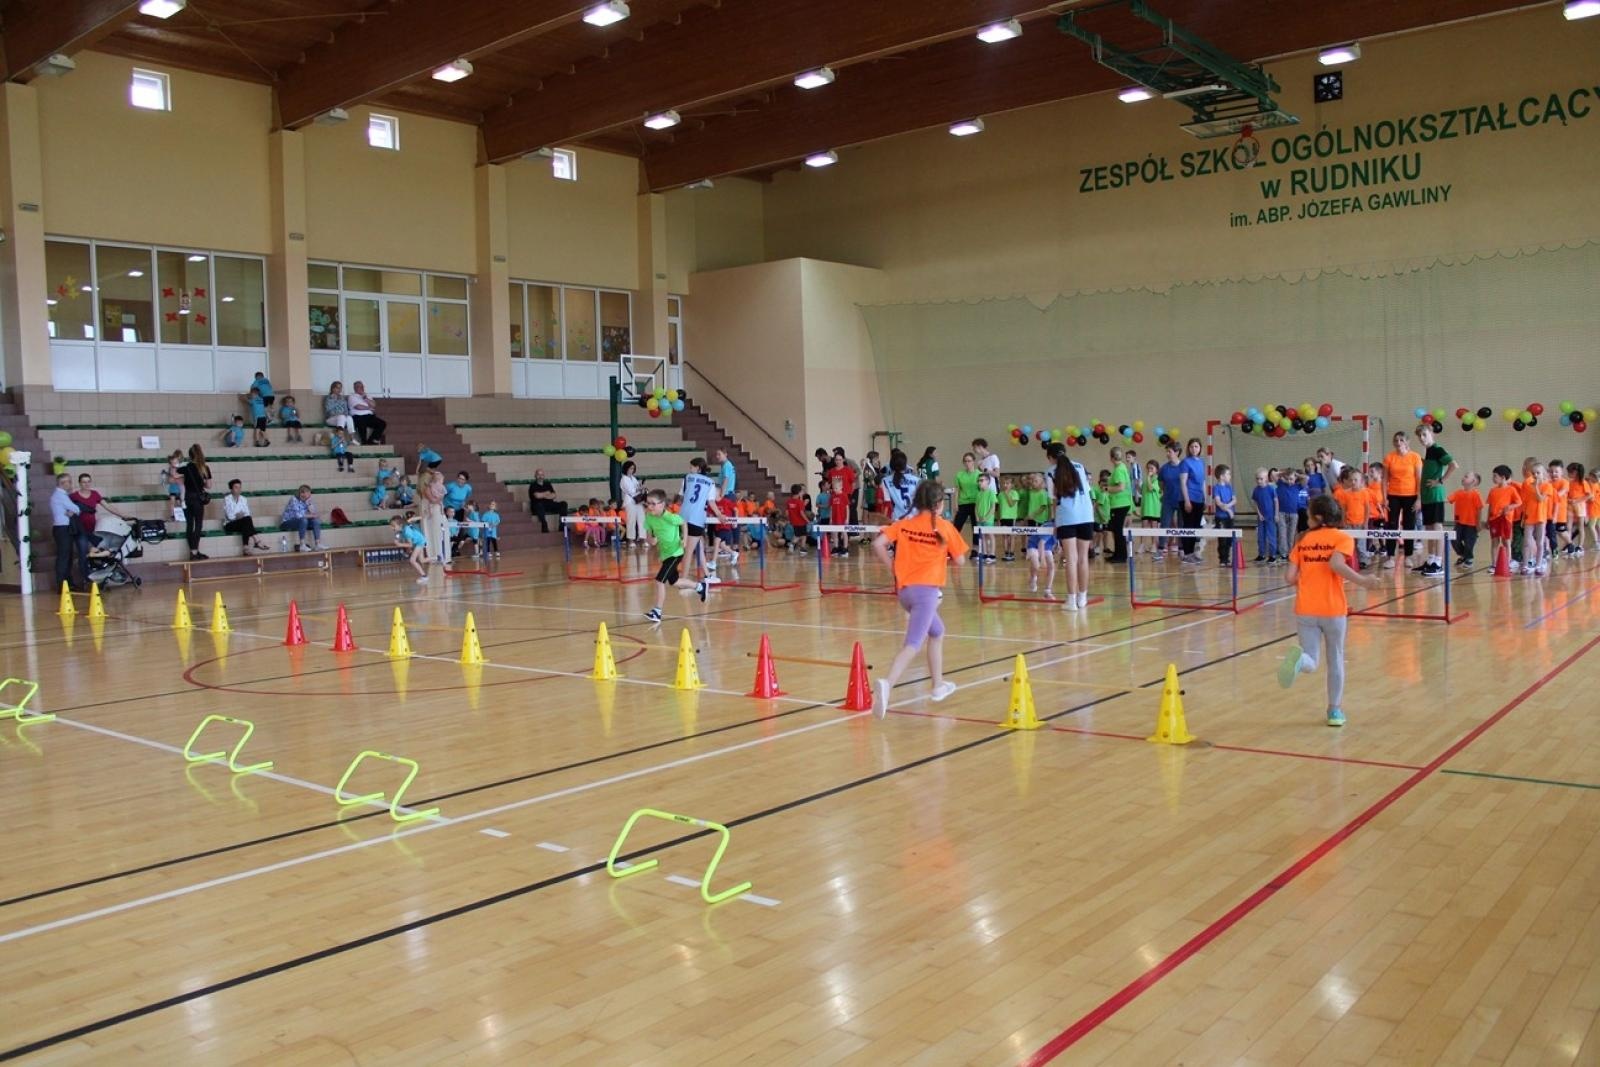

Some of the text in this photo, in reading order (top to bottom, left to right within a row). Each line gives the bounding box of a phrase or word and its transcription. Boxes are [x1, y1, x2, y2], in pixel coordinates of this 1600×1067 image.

[1079, 153, 1174, 193] ZESPÓŁ
[1261, 152, 1421, 199] w RUDNIKU
[1230, 184, 1452, 228] im. ABP. JÓZEFA GAWLINY
[690, 484, 701, 503] 3
[900, 487, 911, 510] 5
[1367, 530, 1402, 538] POLANIK
